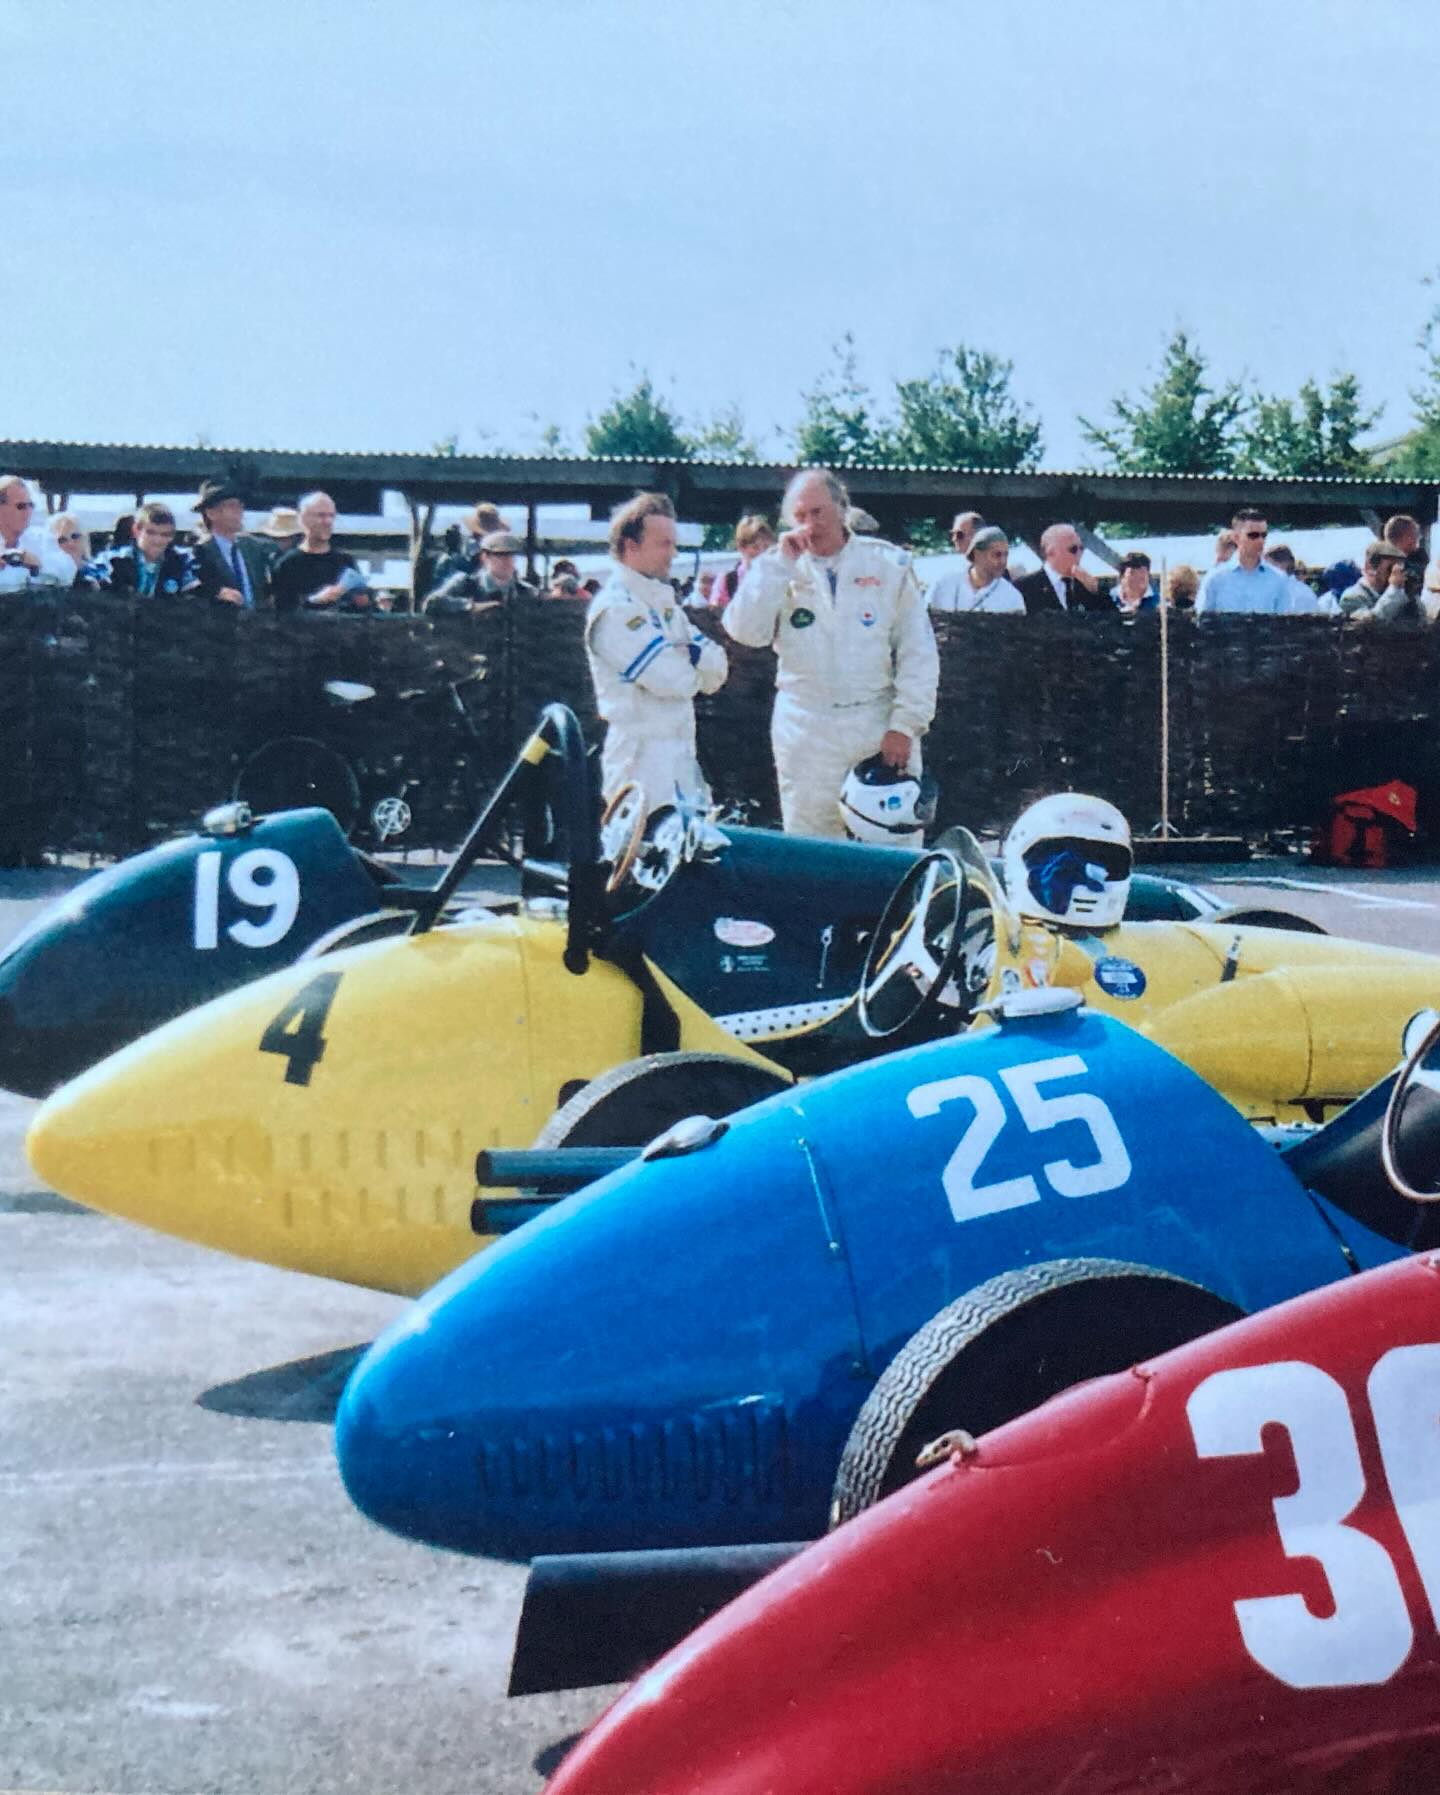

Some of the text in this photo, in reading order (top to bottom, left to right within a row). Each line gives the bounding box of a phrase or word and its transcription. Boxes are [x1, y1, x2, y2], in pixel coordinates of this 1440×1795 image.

[194, 849, 300, 950] 19
[259, 972, 344, 1087] 4
[907, 1055, 1132, 1222] 25
